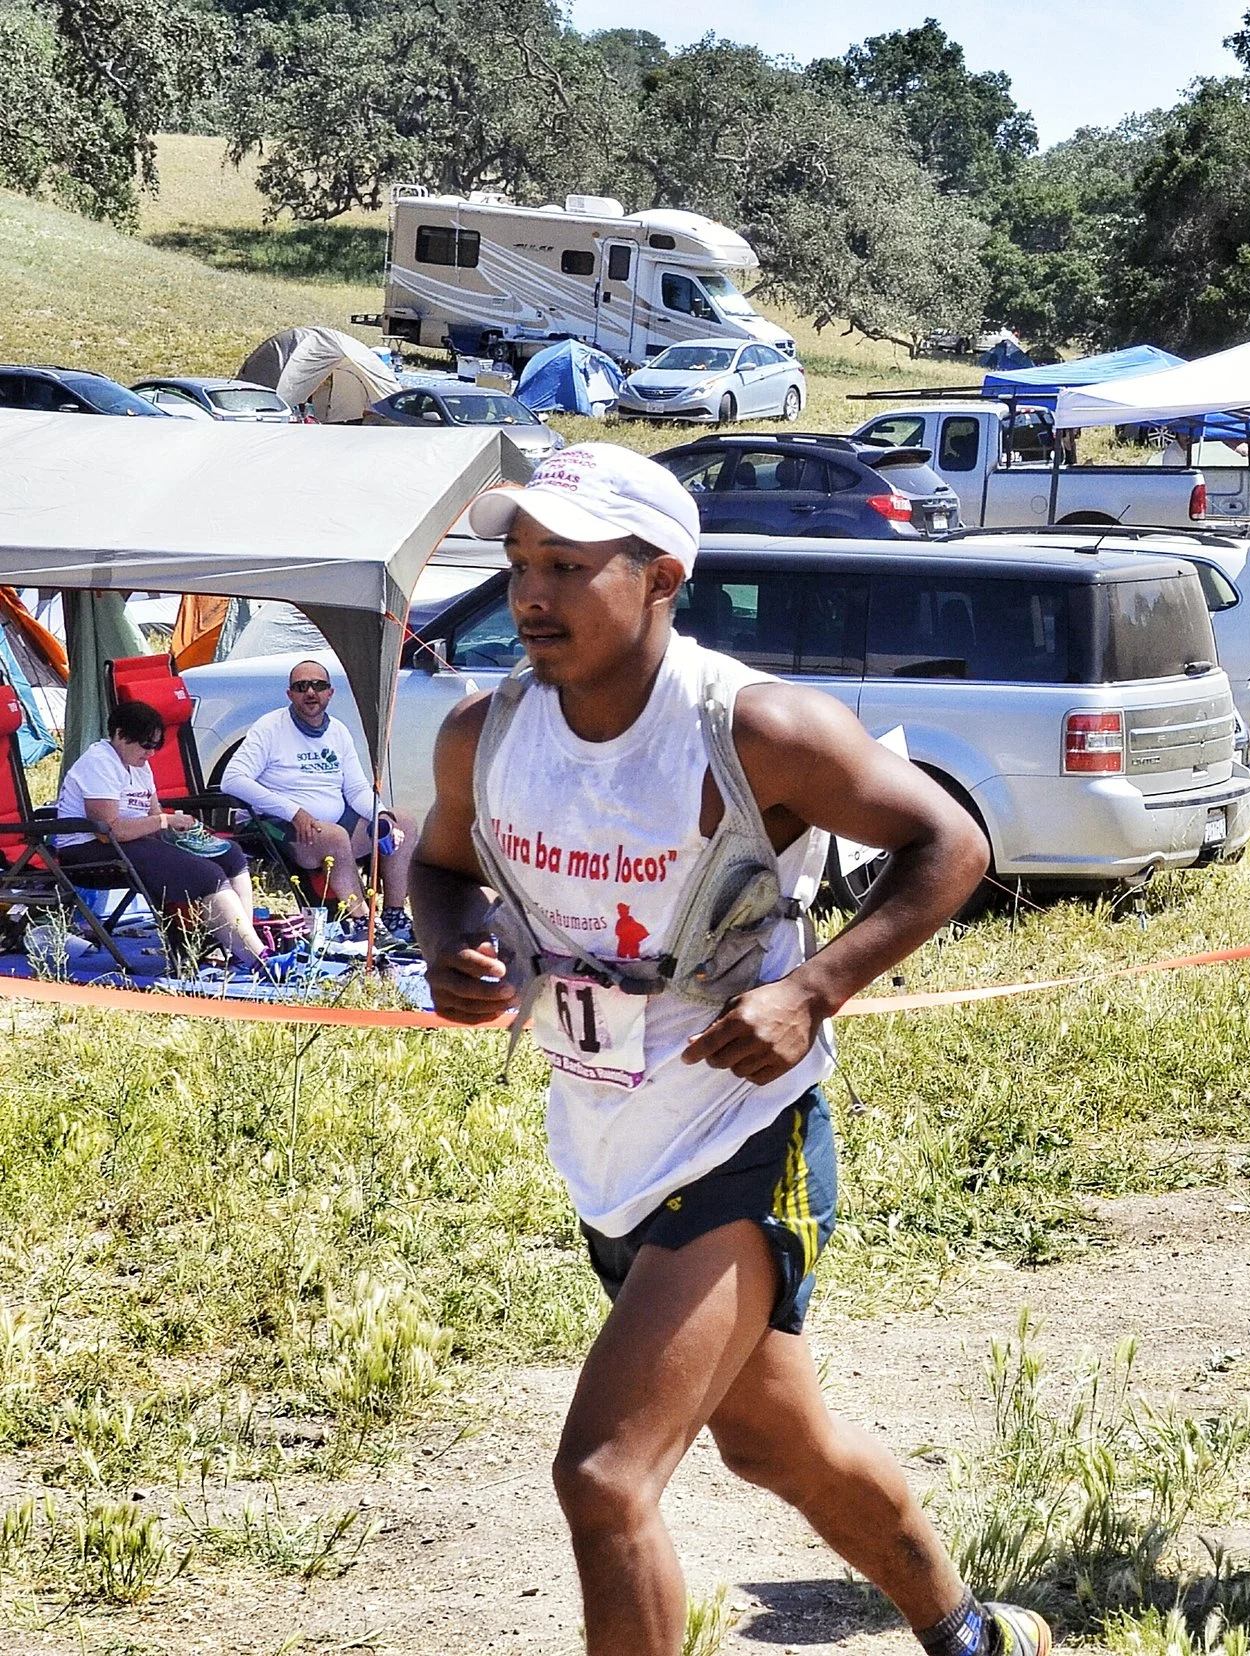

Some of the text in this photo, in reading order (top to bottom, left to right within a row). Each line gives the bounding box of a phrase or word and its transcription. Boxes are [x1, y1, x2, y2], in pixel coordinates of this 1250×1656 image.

[296, 751, 321, 761] SOLE
[535, 831, 562, 873] ba
[567, 850, 610, 881] mas
[556, 981, 601, 1054] 61
